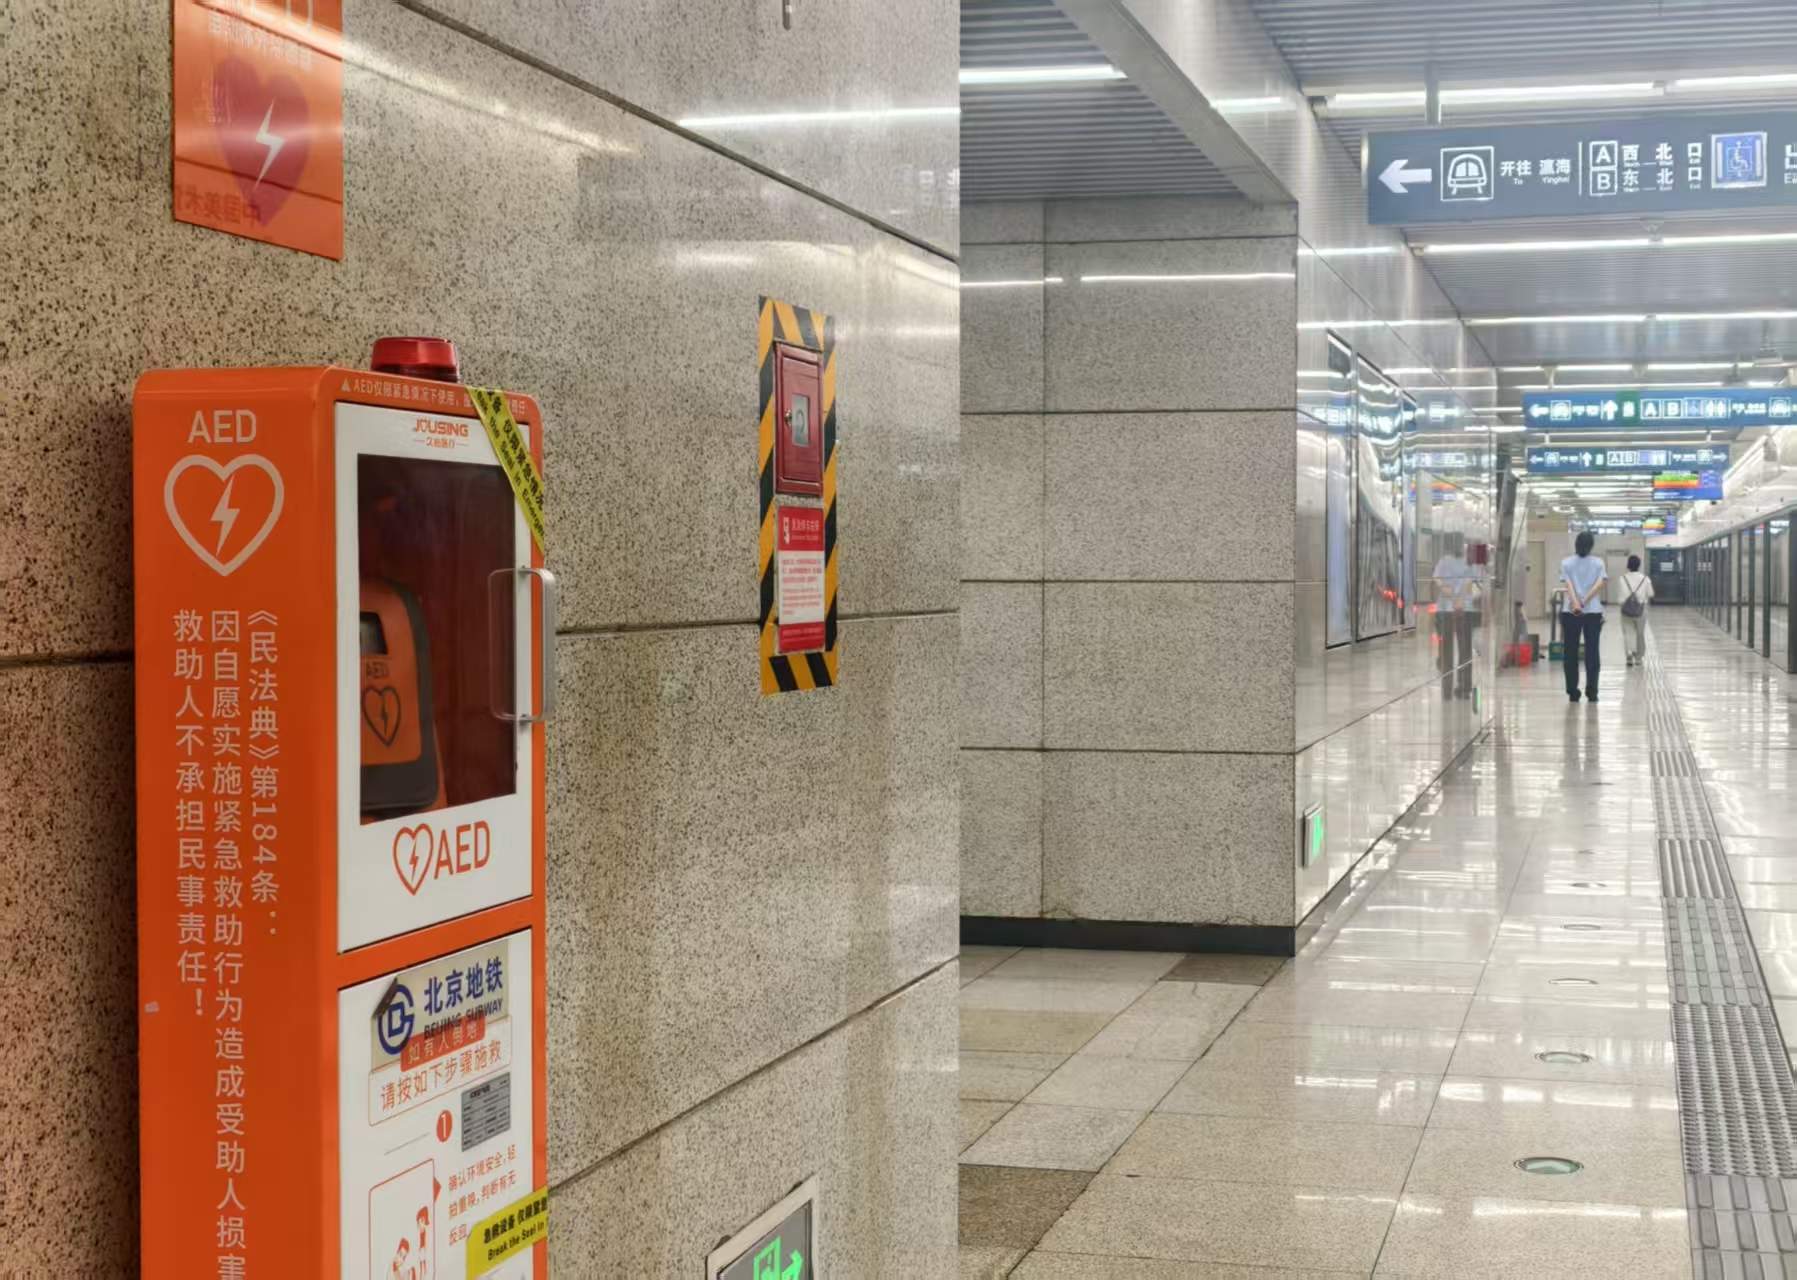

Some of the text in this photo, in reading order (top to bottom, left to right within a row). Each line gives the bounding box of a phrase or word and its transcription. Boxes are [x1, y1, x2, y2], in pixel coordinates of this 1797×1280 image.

[1501, 160, 1532, 176] 开往
[1596, 145, 1611, 163] A
[1597, 173, 1611, 190] B
[187, 409, 257, 444] AED
[1645, 402, 1657, 417] A
[1667, 402, 1679, 417] B
[248, 609, 280, 936] 《民法典》第184条：
[172, 609, 208, 1016] 救助人不承担民事责任！
[434, 820, 490, 880] AED
[210, 609, 247, 1280] 因自愿实施紧急救助行为造成受助人损害
[423, 956, 504, 1016] 北京地铁
[423, 998, 504, 1039] BEIJING SUBWAY
